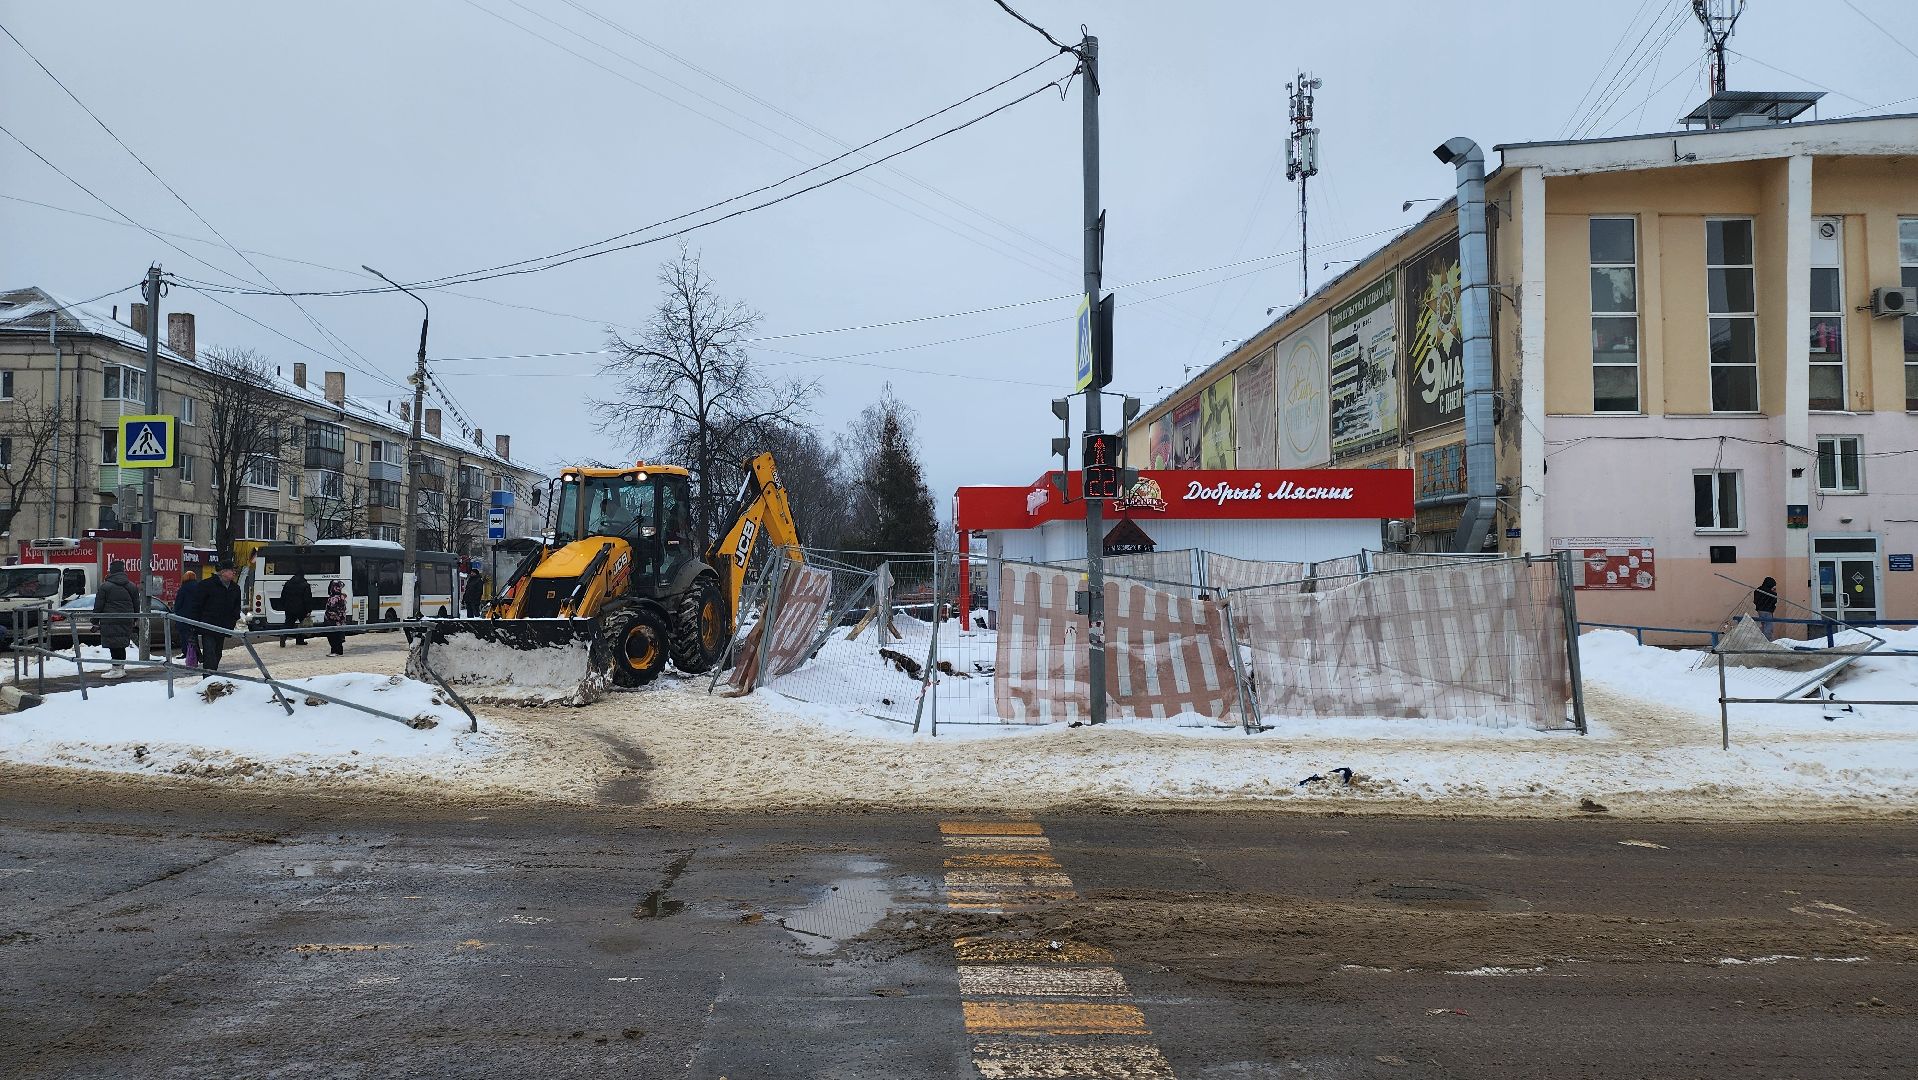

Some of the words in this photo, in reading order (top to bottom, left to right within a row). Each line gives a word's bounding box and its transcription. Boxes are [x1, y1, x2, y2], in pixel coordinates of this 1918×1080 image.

[1420, 347, 1442, 404] 9
[1440, 355, 1465, 391] МА
[1090, 468, 1115, 496] 22
[1183, 480, 1262, 506] Добрый
[1267, 480, 1354, 500] Мясник
[735, 520, 757, 568] JCB
[613, 552, 628, 576] JCB
